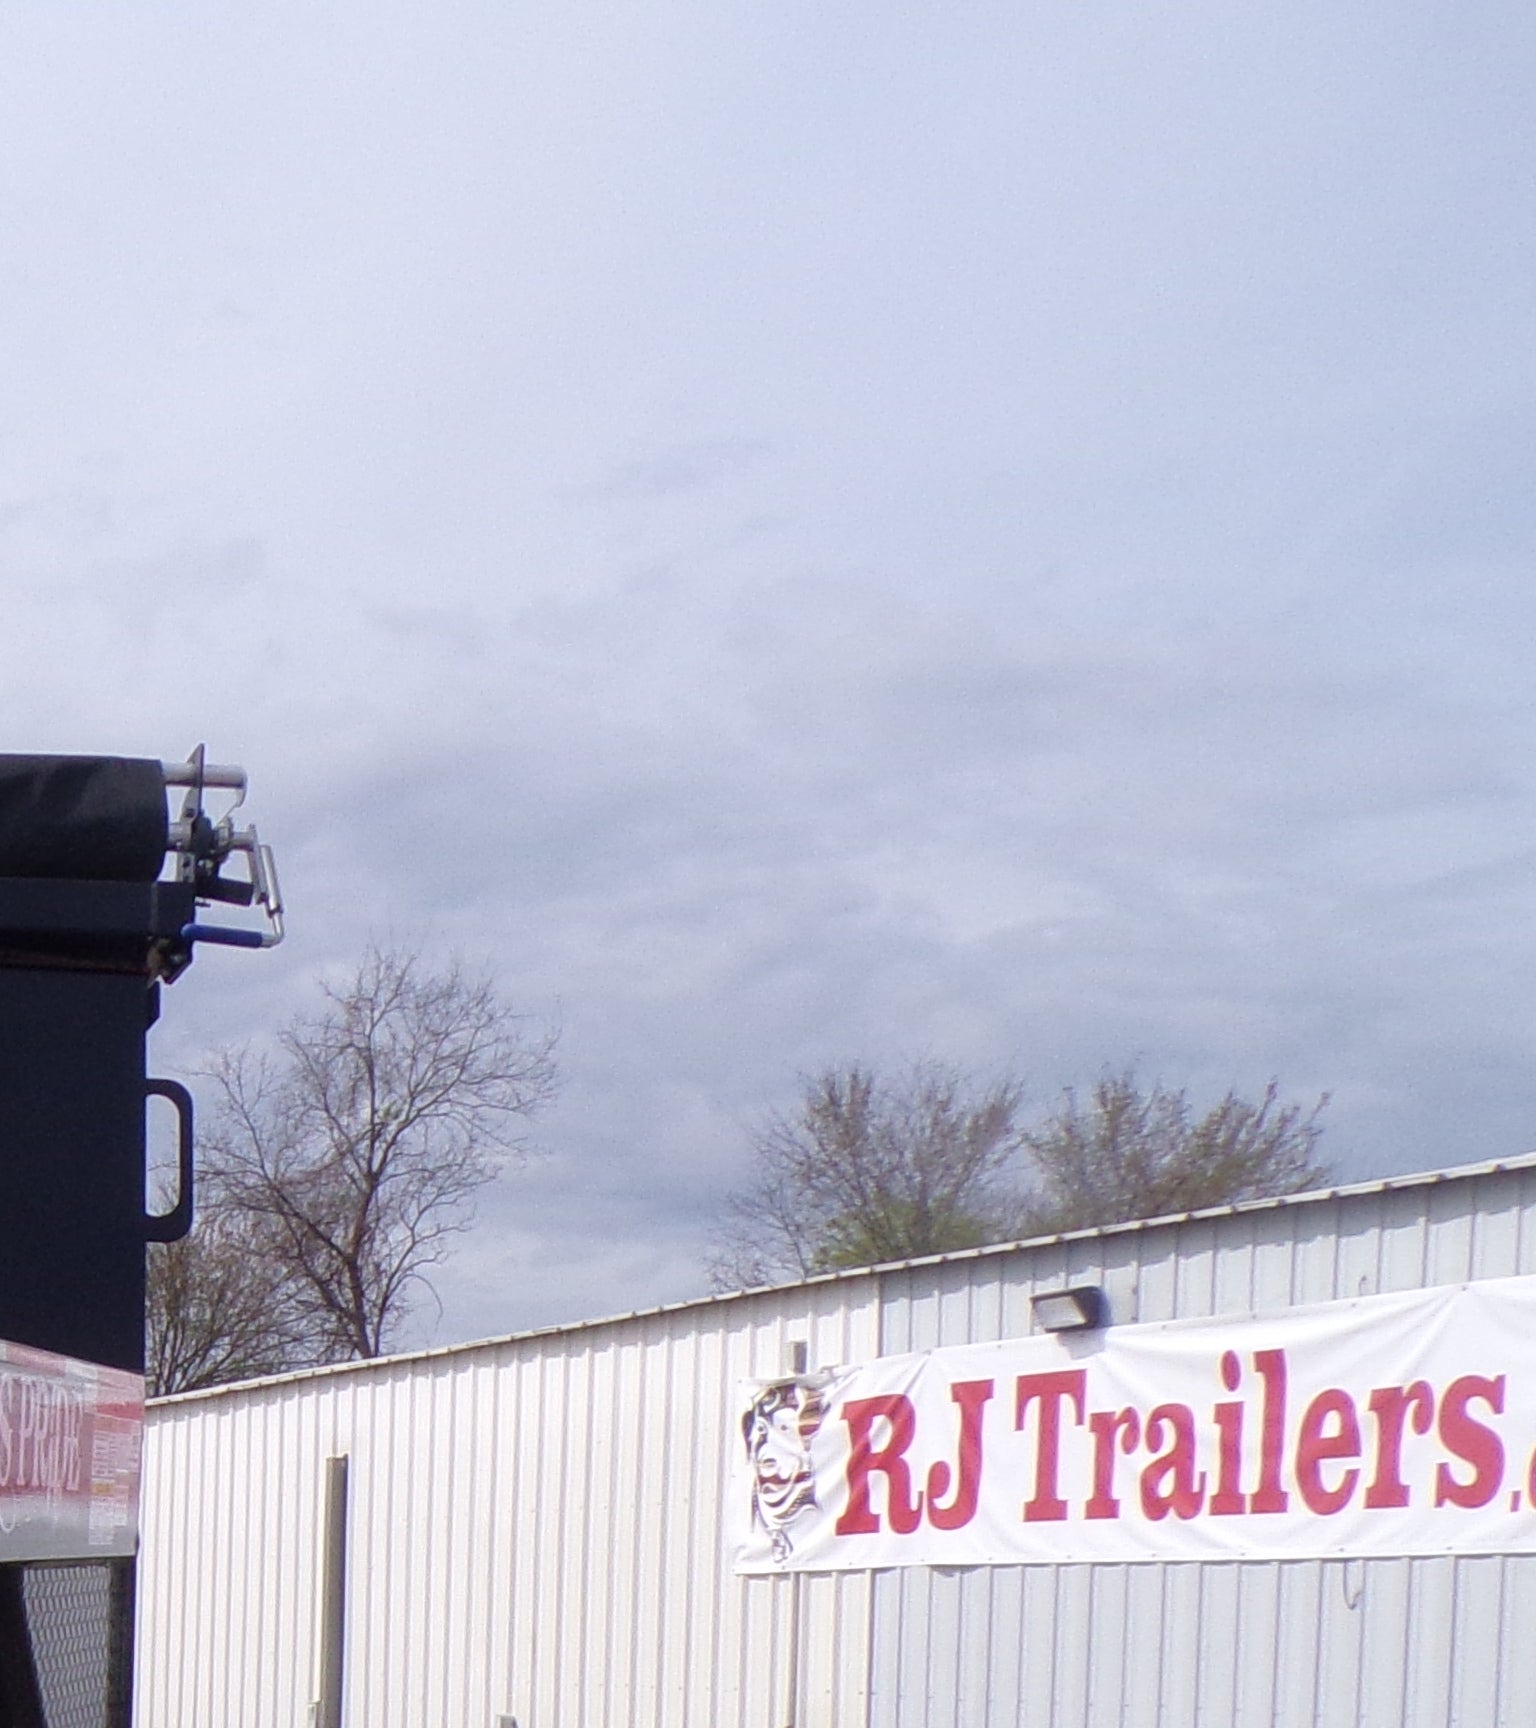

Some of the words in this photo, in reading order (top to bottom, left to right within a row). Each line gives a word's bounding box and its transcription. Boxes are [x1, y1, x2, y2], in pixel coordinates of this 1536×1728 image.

[16, 1374, 86, 1522] PRIDE
[834, 1378, 995, 1536] RJ
[1013, 1348, 1536, 1522] Trailers.
